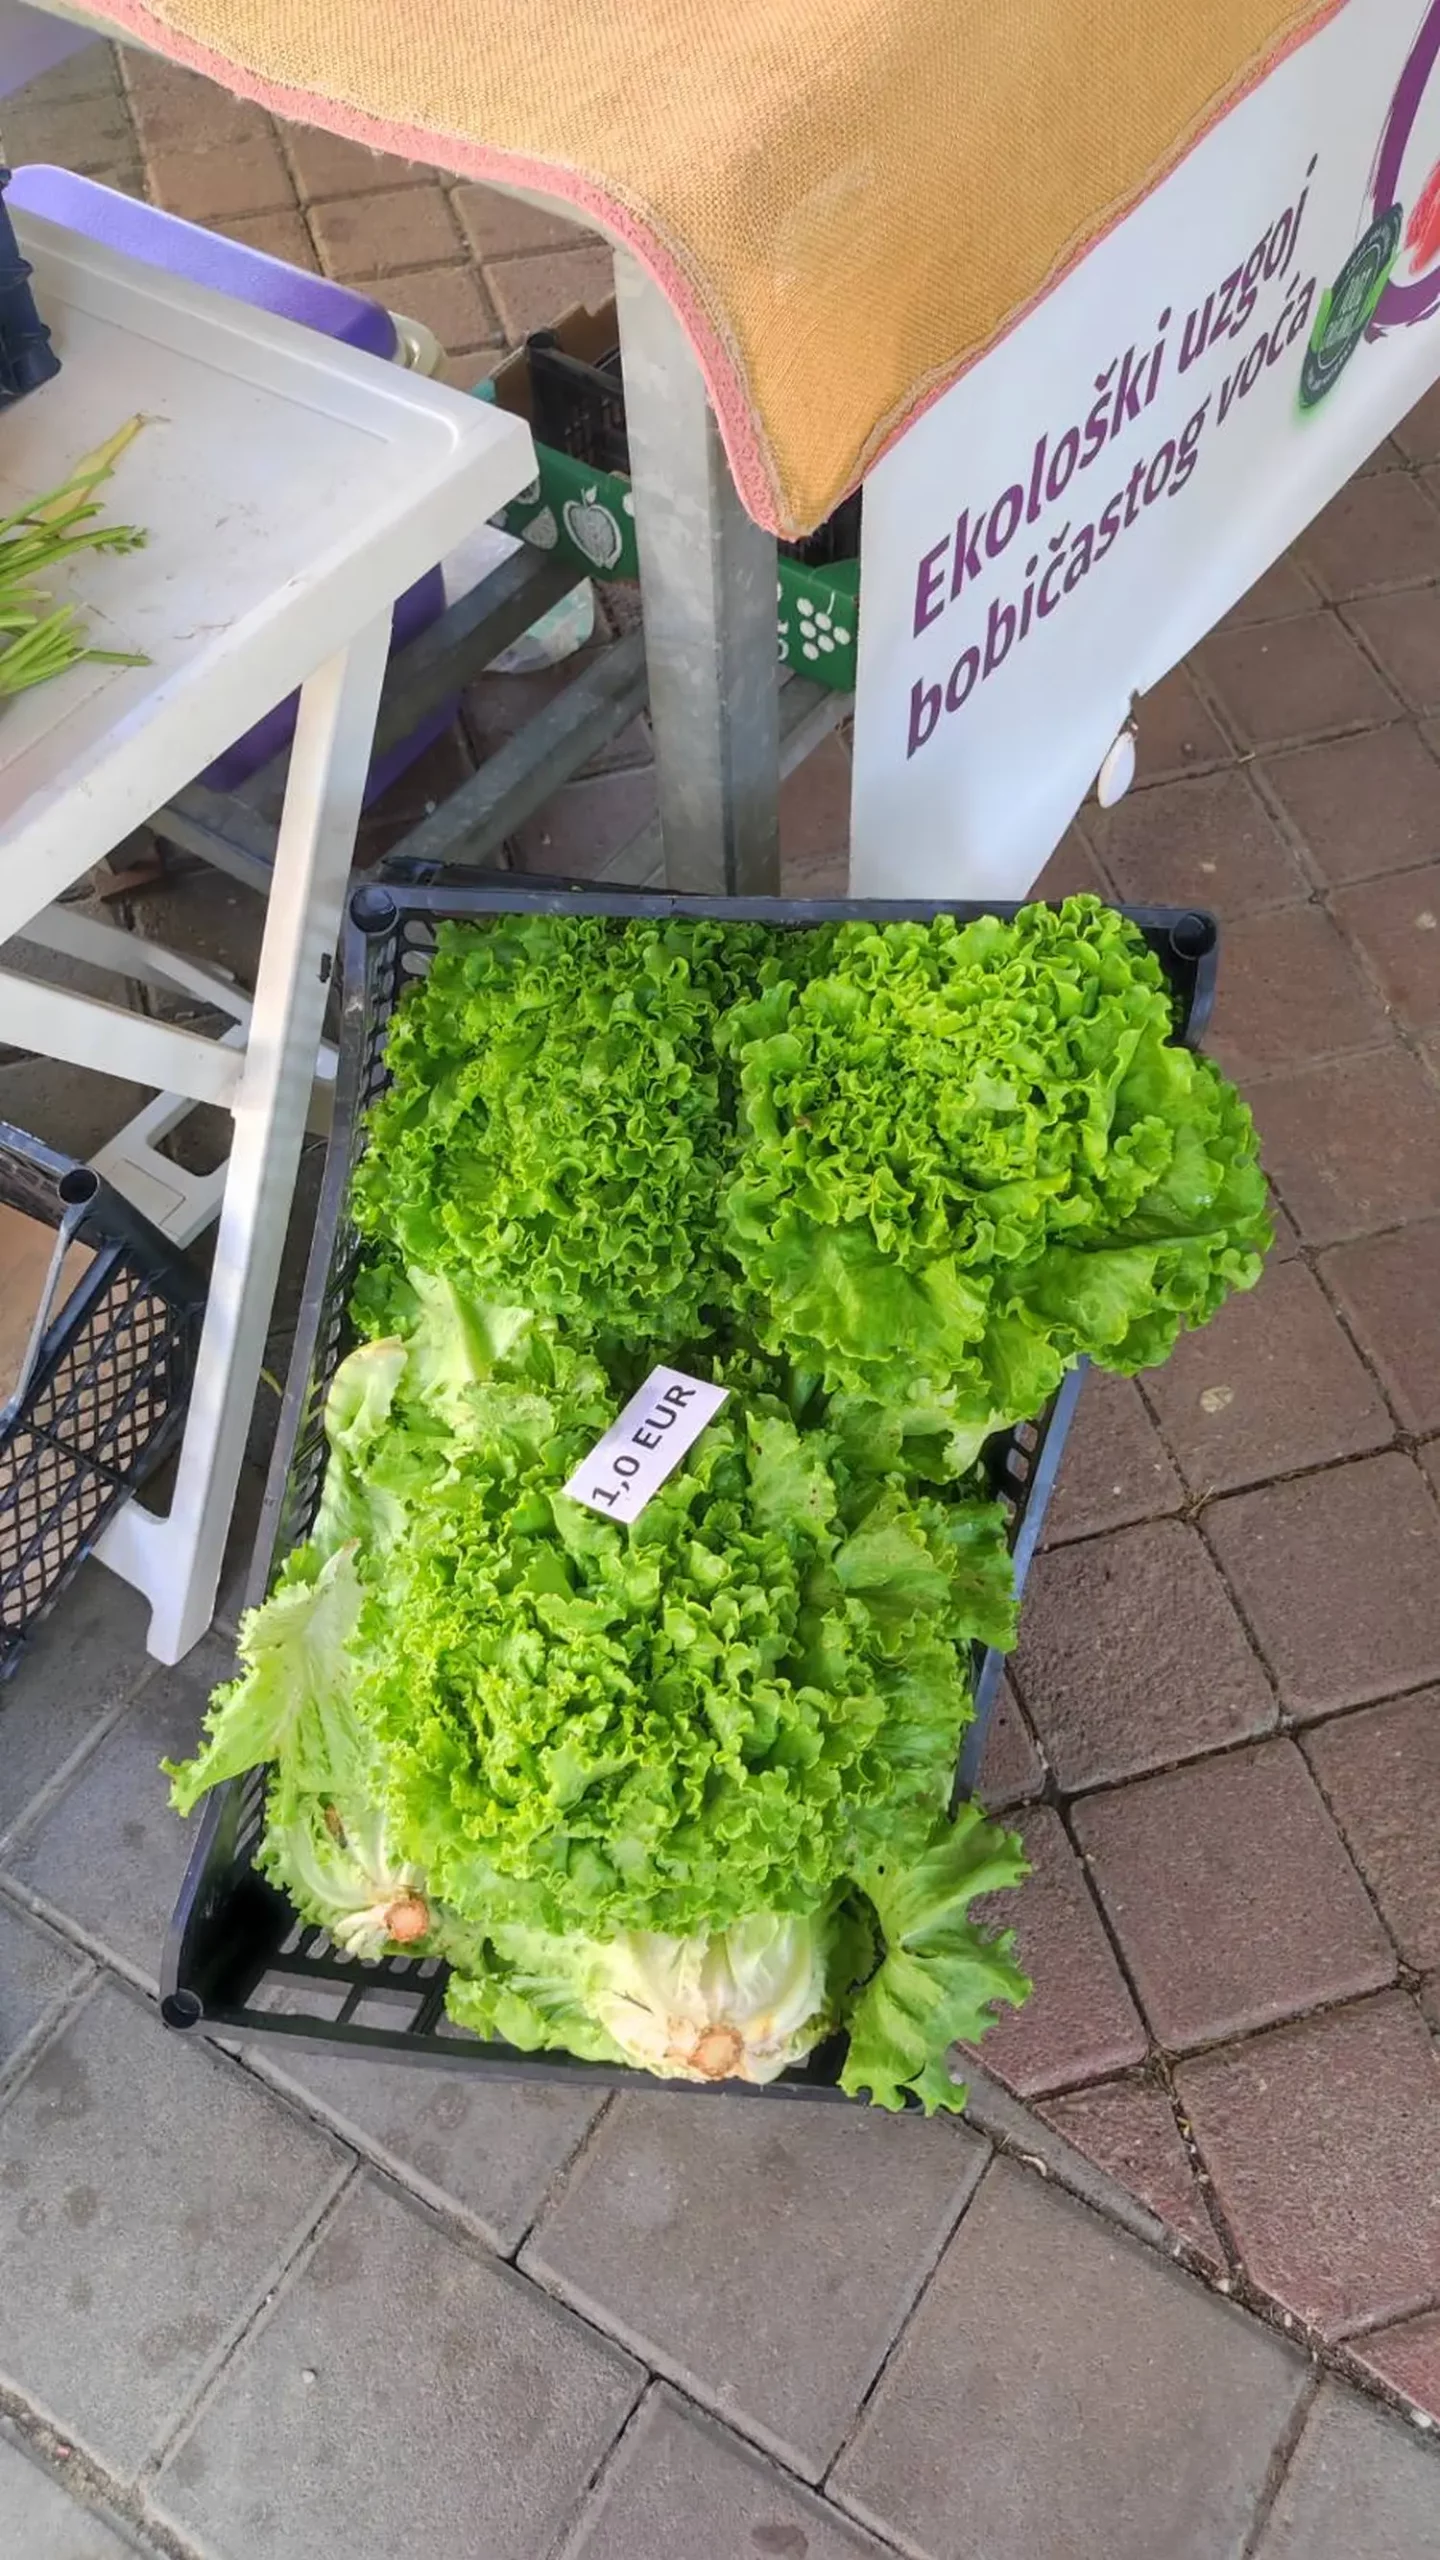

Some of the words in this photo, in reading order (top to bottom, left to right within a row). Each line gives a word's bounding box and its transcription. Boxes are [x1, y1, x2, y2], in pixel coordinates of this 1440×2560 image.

[906, 394, 1210, 760] bobičastog
[1216, 270, 1317, 423] voća
[913, 308, 1170, 639] Ekološki
[1177, 153, 1318, 380] uzgoj
[592, 1455, 640, 1506] 1,0
[632, 1385, 697, 1450] EUR
